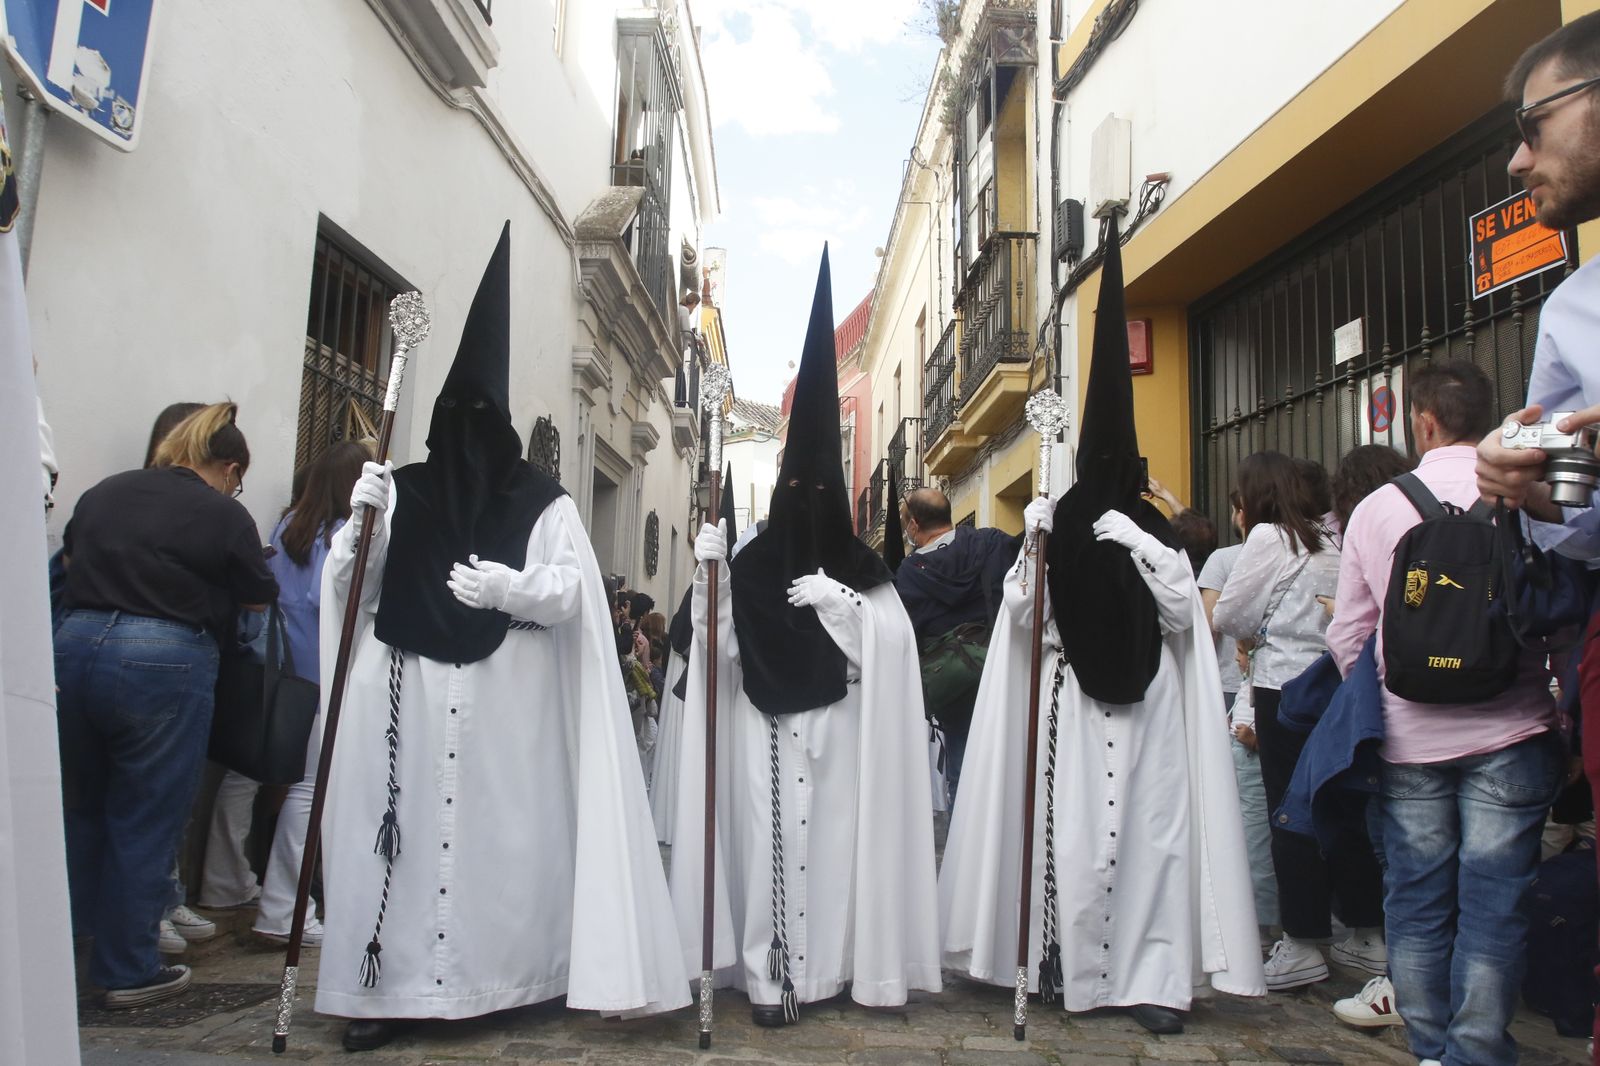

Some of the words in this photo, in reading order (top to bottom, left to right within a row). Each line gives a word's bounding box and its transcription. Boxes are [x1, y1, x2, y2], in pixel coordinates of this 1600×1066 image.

[1476, 213, 1497, 242] SE
[1501, 197, 1537, 230] VEN
[1428, 656, 1462, 669] TENTH
